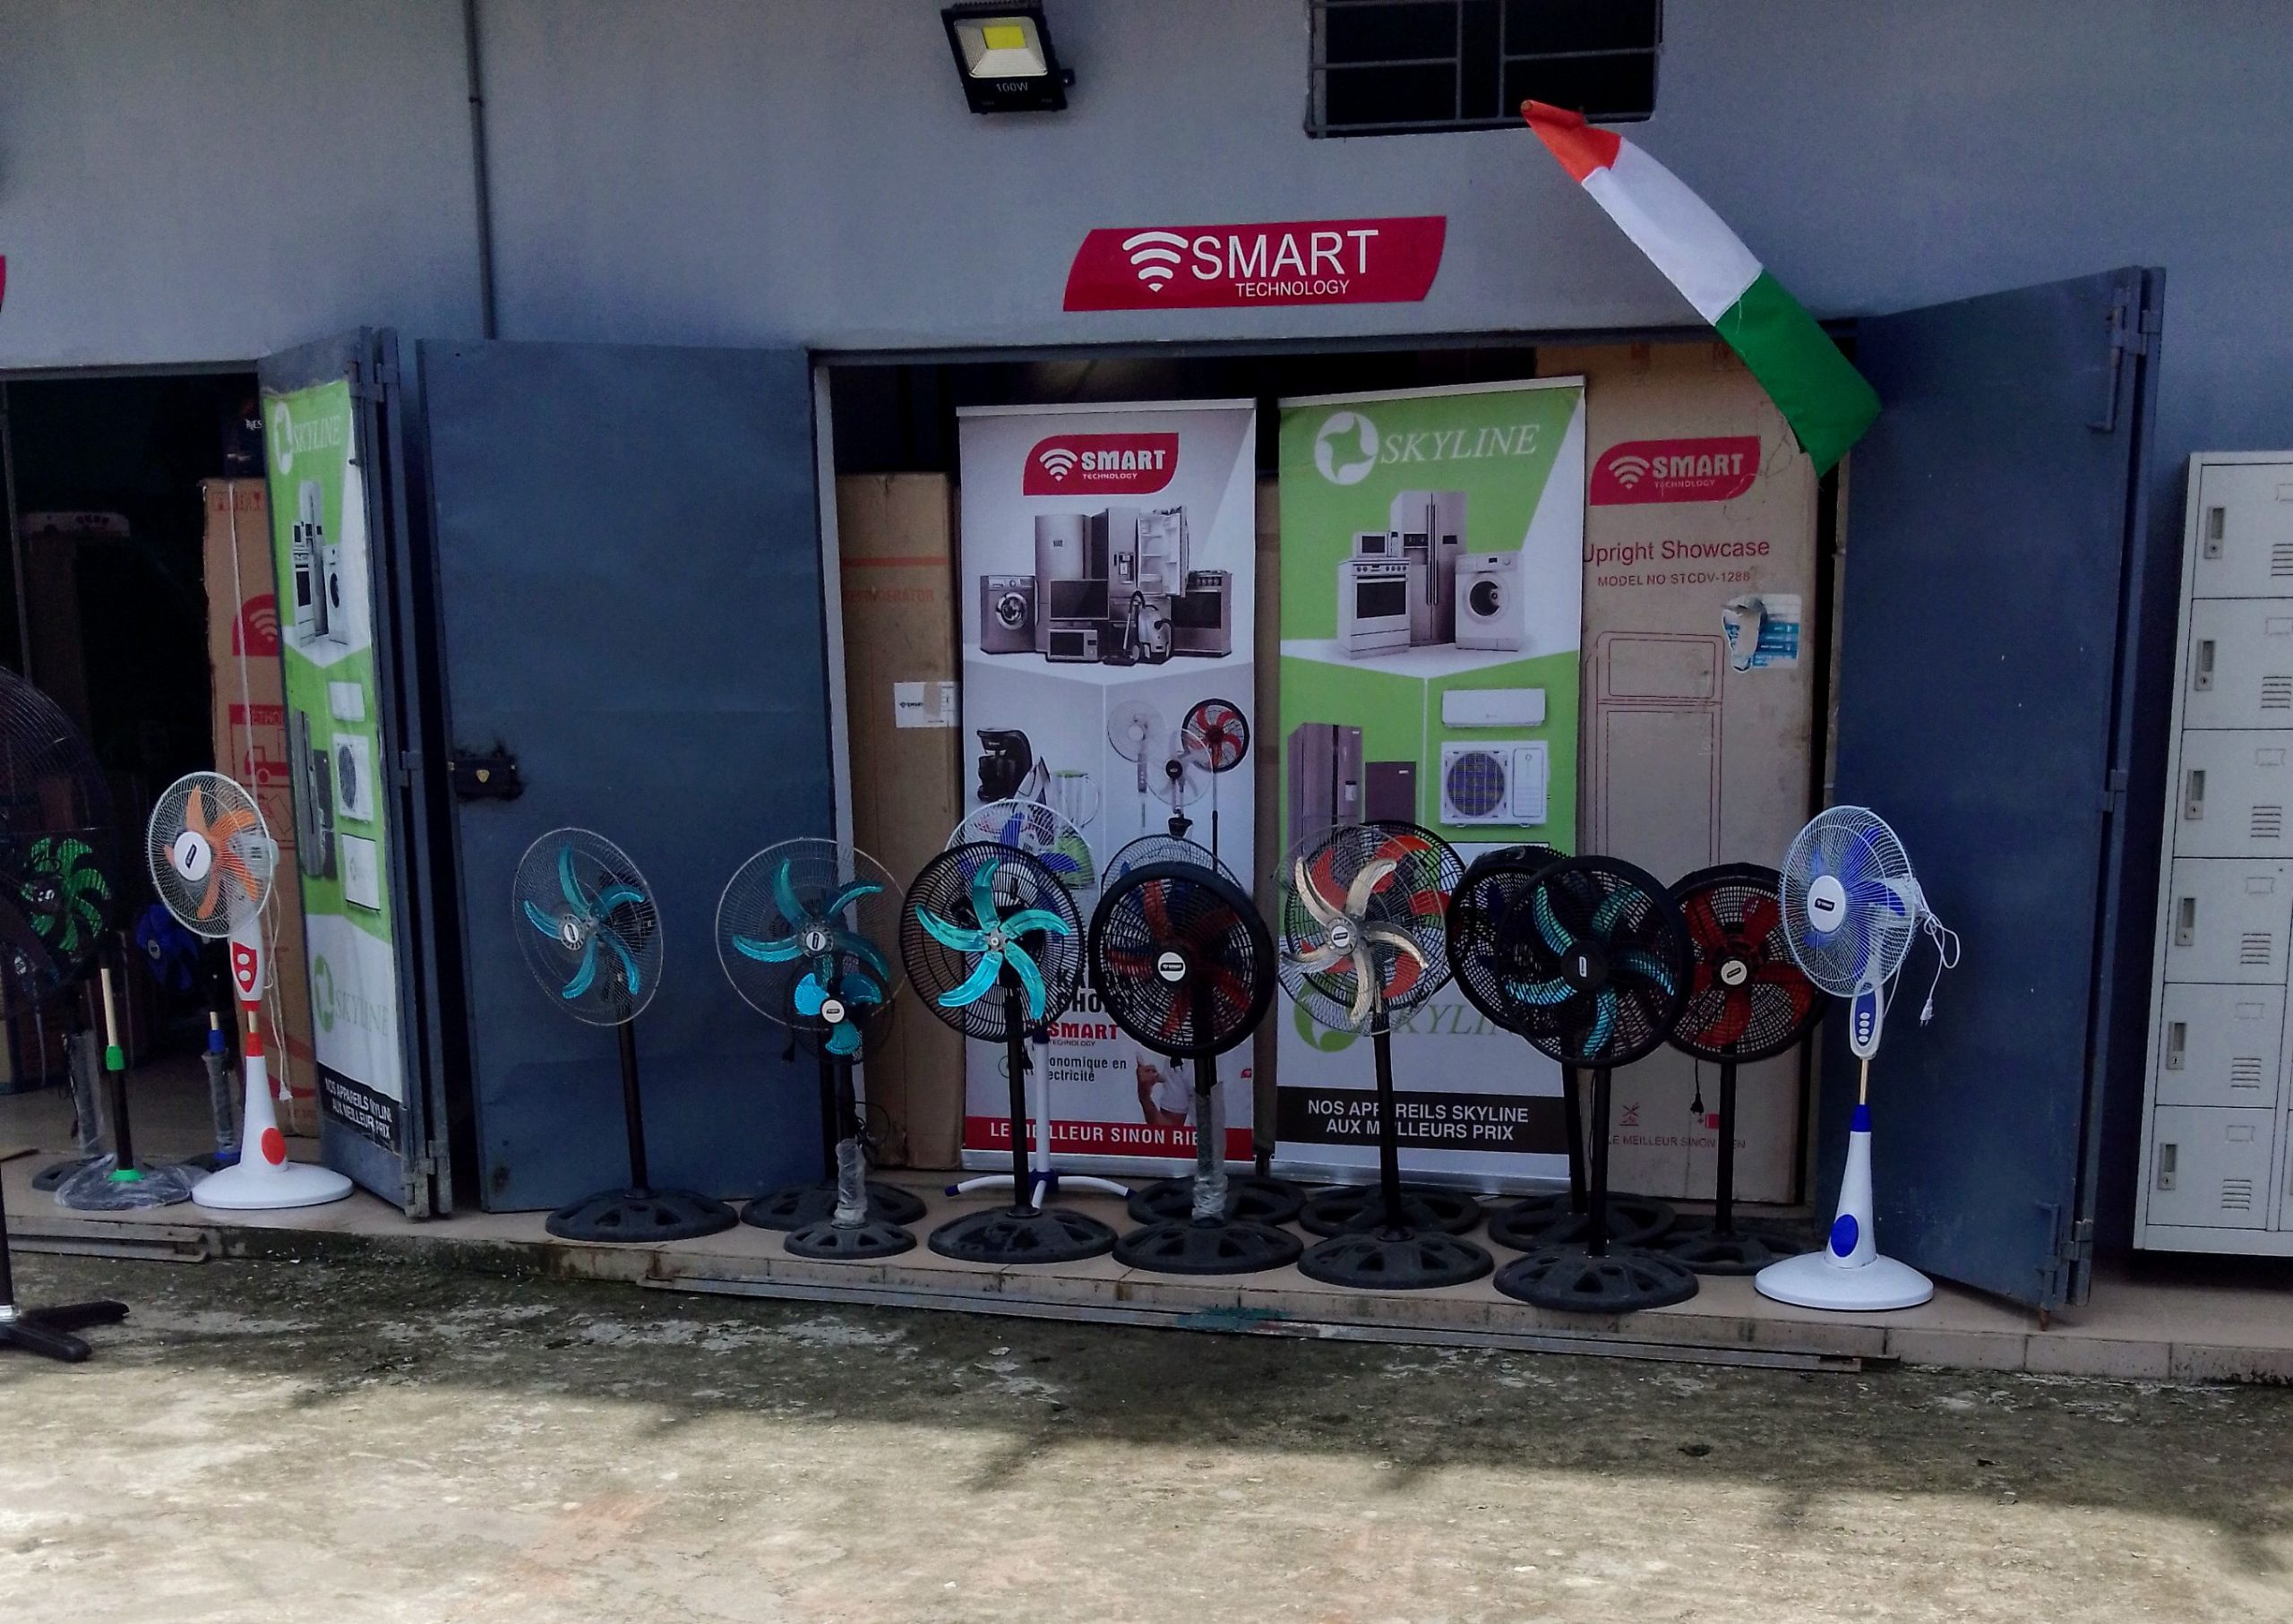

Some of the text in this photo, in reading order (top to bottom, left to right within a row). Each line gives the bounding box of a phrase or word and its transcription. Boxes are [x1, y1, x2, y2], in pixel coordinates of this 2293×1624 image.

[995, 82, 1028, 92] 100W
[1190, 228, 1380, 281] SMART
[1234, 279, 1350, 298] TECHNOLOGY
[293, 415, 341, 454] SKYLINE
[1380, 424, 1541, 465] SKYLINE
[1080, 450, 1166, 471] SMART
[1652, 453, 1745, 478] SMART
[1082, 472, 1138, 480] TECHNOLOGY
[1654, 478, 1716, 489] TECHNOLOGY
[1661, 539, 1771, 560] Showcase
[1597, 574, 1644, 588] MODEL
[1646, 574, 1666, 586] NO
[335, 988, 390, 1037] SKYLINE
[1047, 1022, 1119, 1040] SMART
[1049, 1056, 1127, 1070] onomique en
[1049, 1068, 1095, 1082] ectricité
[336, 1082, 370, 1112] APPAREILS
[1308, 1099, 1529, 1123] NOS APPREILS SKYLINE
[374, 1119, 391, 1140] PRIX
[990, 1121, 1010, 1138] LE
[1110, 1126, 1165, 1145] SINON
[1172, 1129, 1198, 1146] RIE
[1326, 1118, 1515, 1141] AUX MLLEURS PRIX
[1622, 1134, 1679, 1147] MEILLEUR
[1680, 1137, 1716, 1148] SINON
